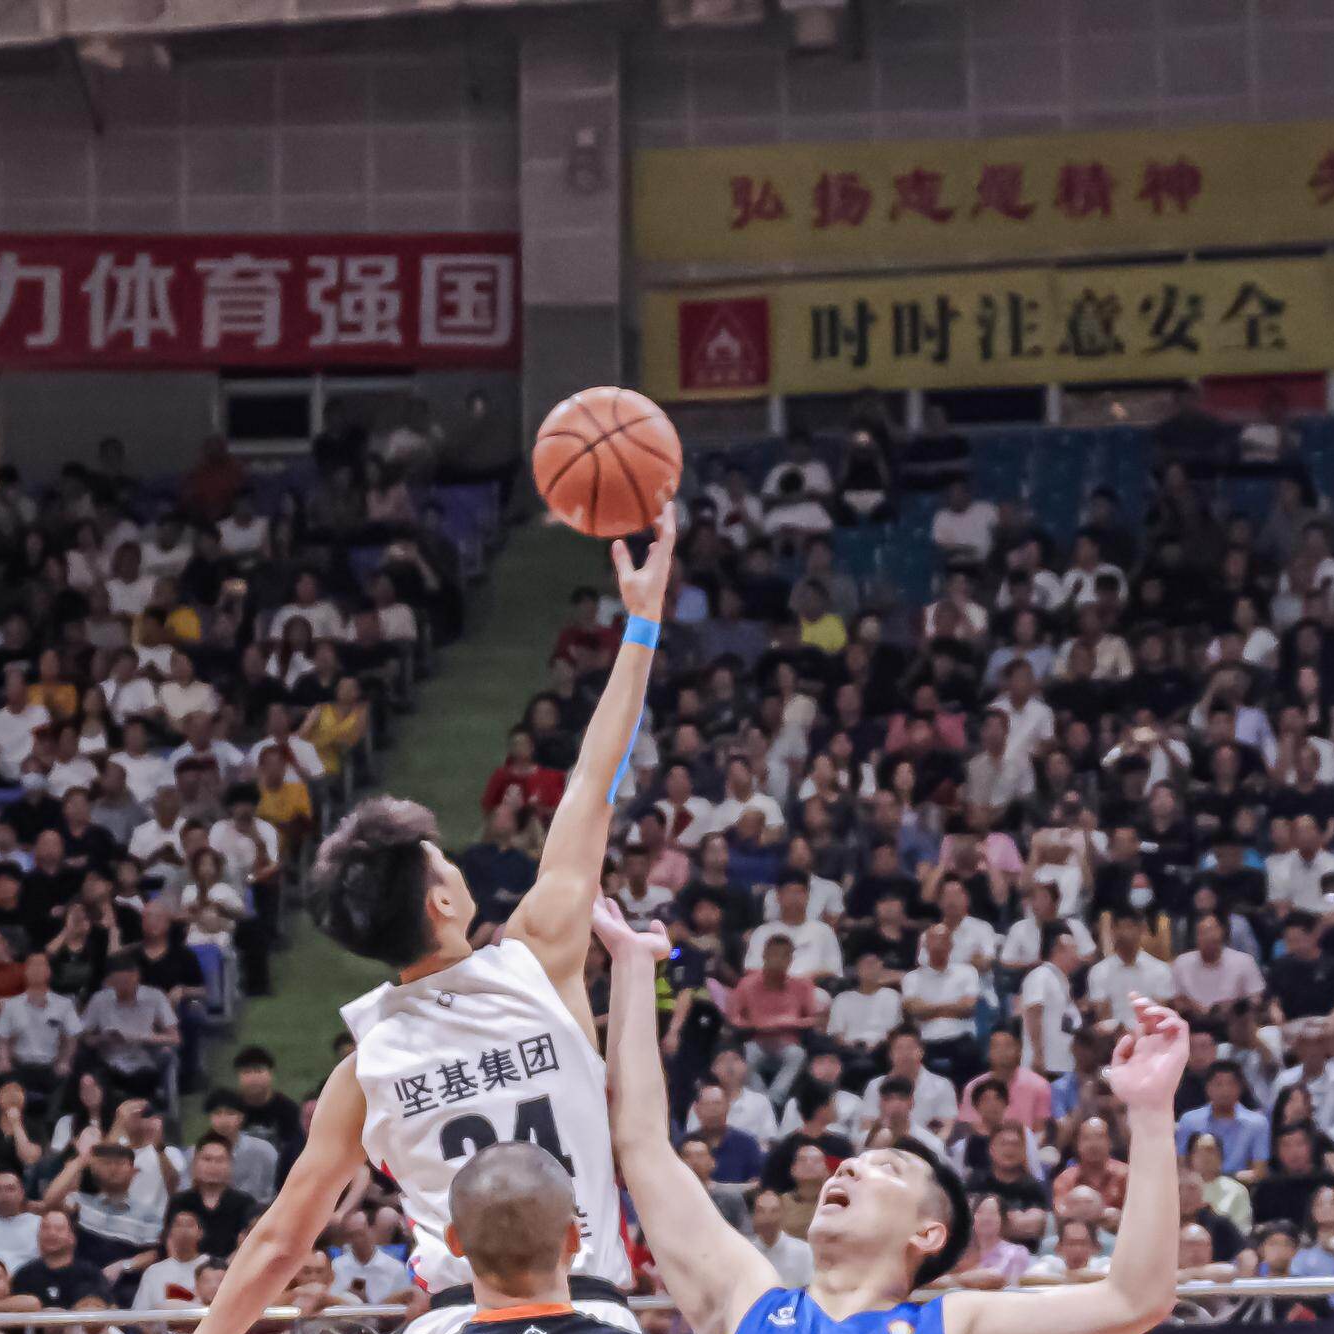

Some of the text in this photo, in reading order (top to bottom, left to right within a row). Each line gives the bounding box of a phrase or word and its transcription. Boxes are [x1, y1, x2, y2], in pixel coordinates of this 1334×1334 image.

[810, 281, 1288, 370] 时时注意安全
[394, 1032, 561, 1118] 坚基集团
